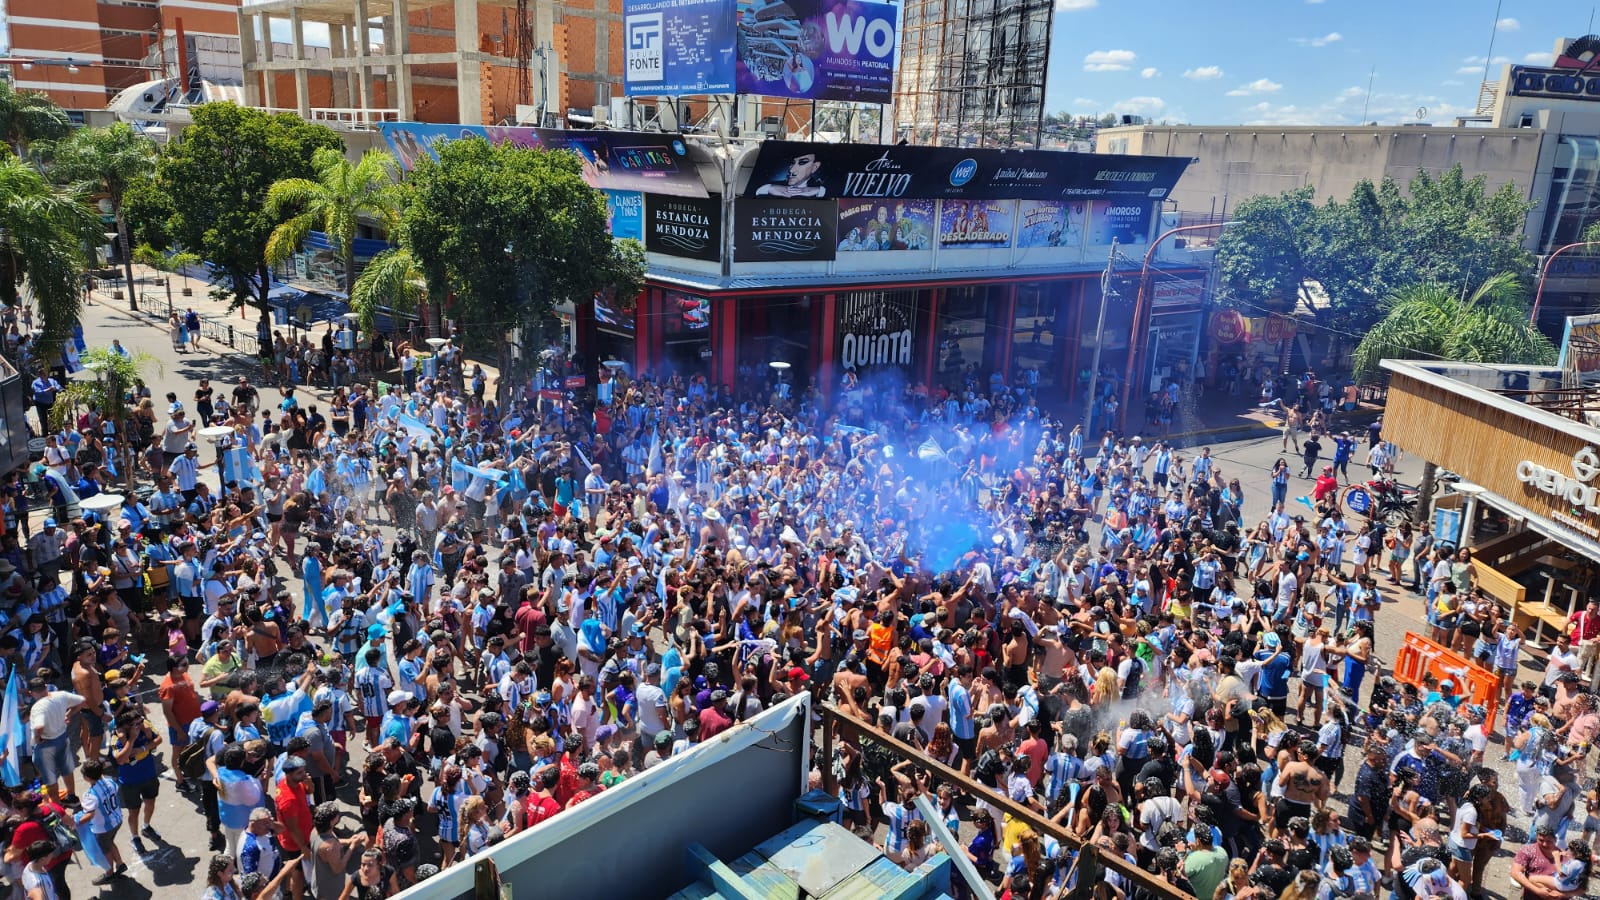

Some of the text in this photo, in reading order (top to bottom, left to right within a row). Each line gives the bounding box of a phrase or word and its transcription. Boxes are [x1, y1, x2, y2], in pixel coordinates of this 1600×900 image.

[826, 11, 894, 58] WO
[630, 57, 660, 69] FONTE
[861, 60, 890, 69] PEATONAL
[842, 172, 912, 198] VUELVO
[668, 202, 697, 212] BODEGA
[769, 207, 807, 215] BODEGA
[840, 204, 873, 220] PABLO REY
[1104, 207, 1141, 216] AMOROSO
[656, 210, 709, 225] ESTANCIA
[752, 217, 821, 227] ESTANCIA
[656, 224, 709, 239] MENDOZA
[752, 230, 821, 240] MENDOZA
[940, 231, 1009, 242] DESCADERADO
[874, 316, 887, 330] LA
[1354, 492, 1364, 503] E
[360, 682, 375, 699] 10
[102, 793, 119, 816] 10
